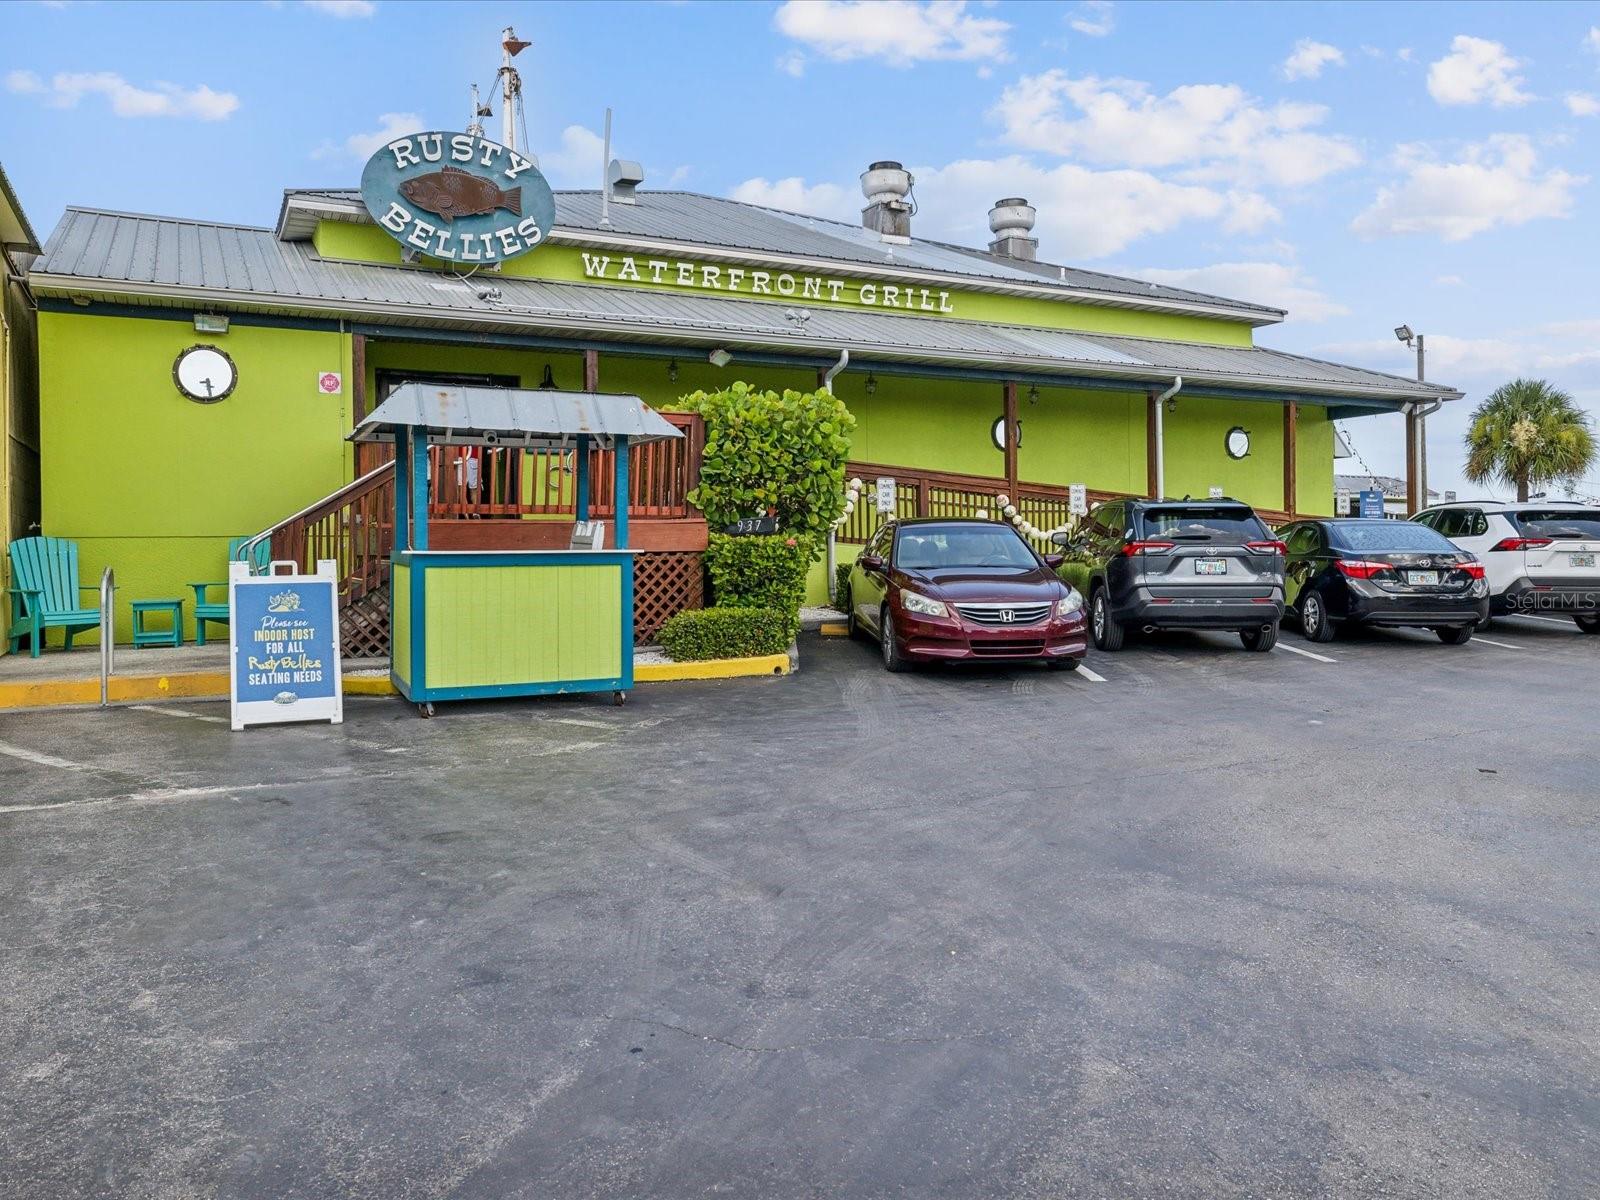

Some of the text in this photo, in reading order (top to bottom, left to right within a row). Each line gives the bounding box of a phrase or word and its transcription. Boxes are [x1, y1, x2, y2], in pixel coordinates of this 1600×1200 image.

[388, 134, 532, 179] RUSTY
[380, 202, 542, 260] BELLIES
[582, 253, 953, 312] WATERFRONT GRILL
[737, 520, 761, 532] 937
[261, 615, 292, 630] Please
[254, 628, 315, 642] INDOOR HOST
[266, 641, 305, 654] FOR ALL
[249, 653, 322, 672] Rusty Bellies
[249, 670, 322, 685] SEATING NEEDS
